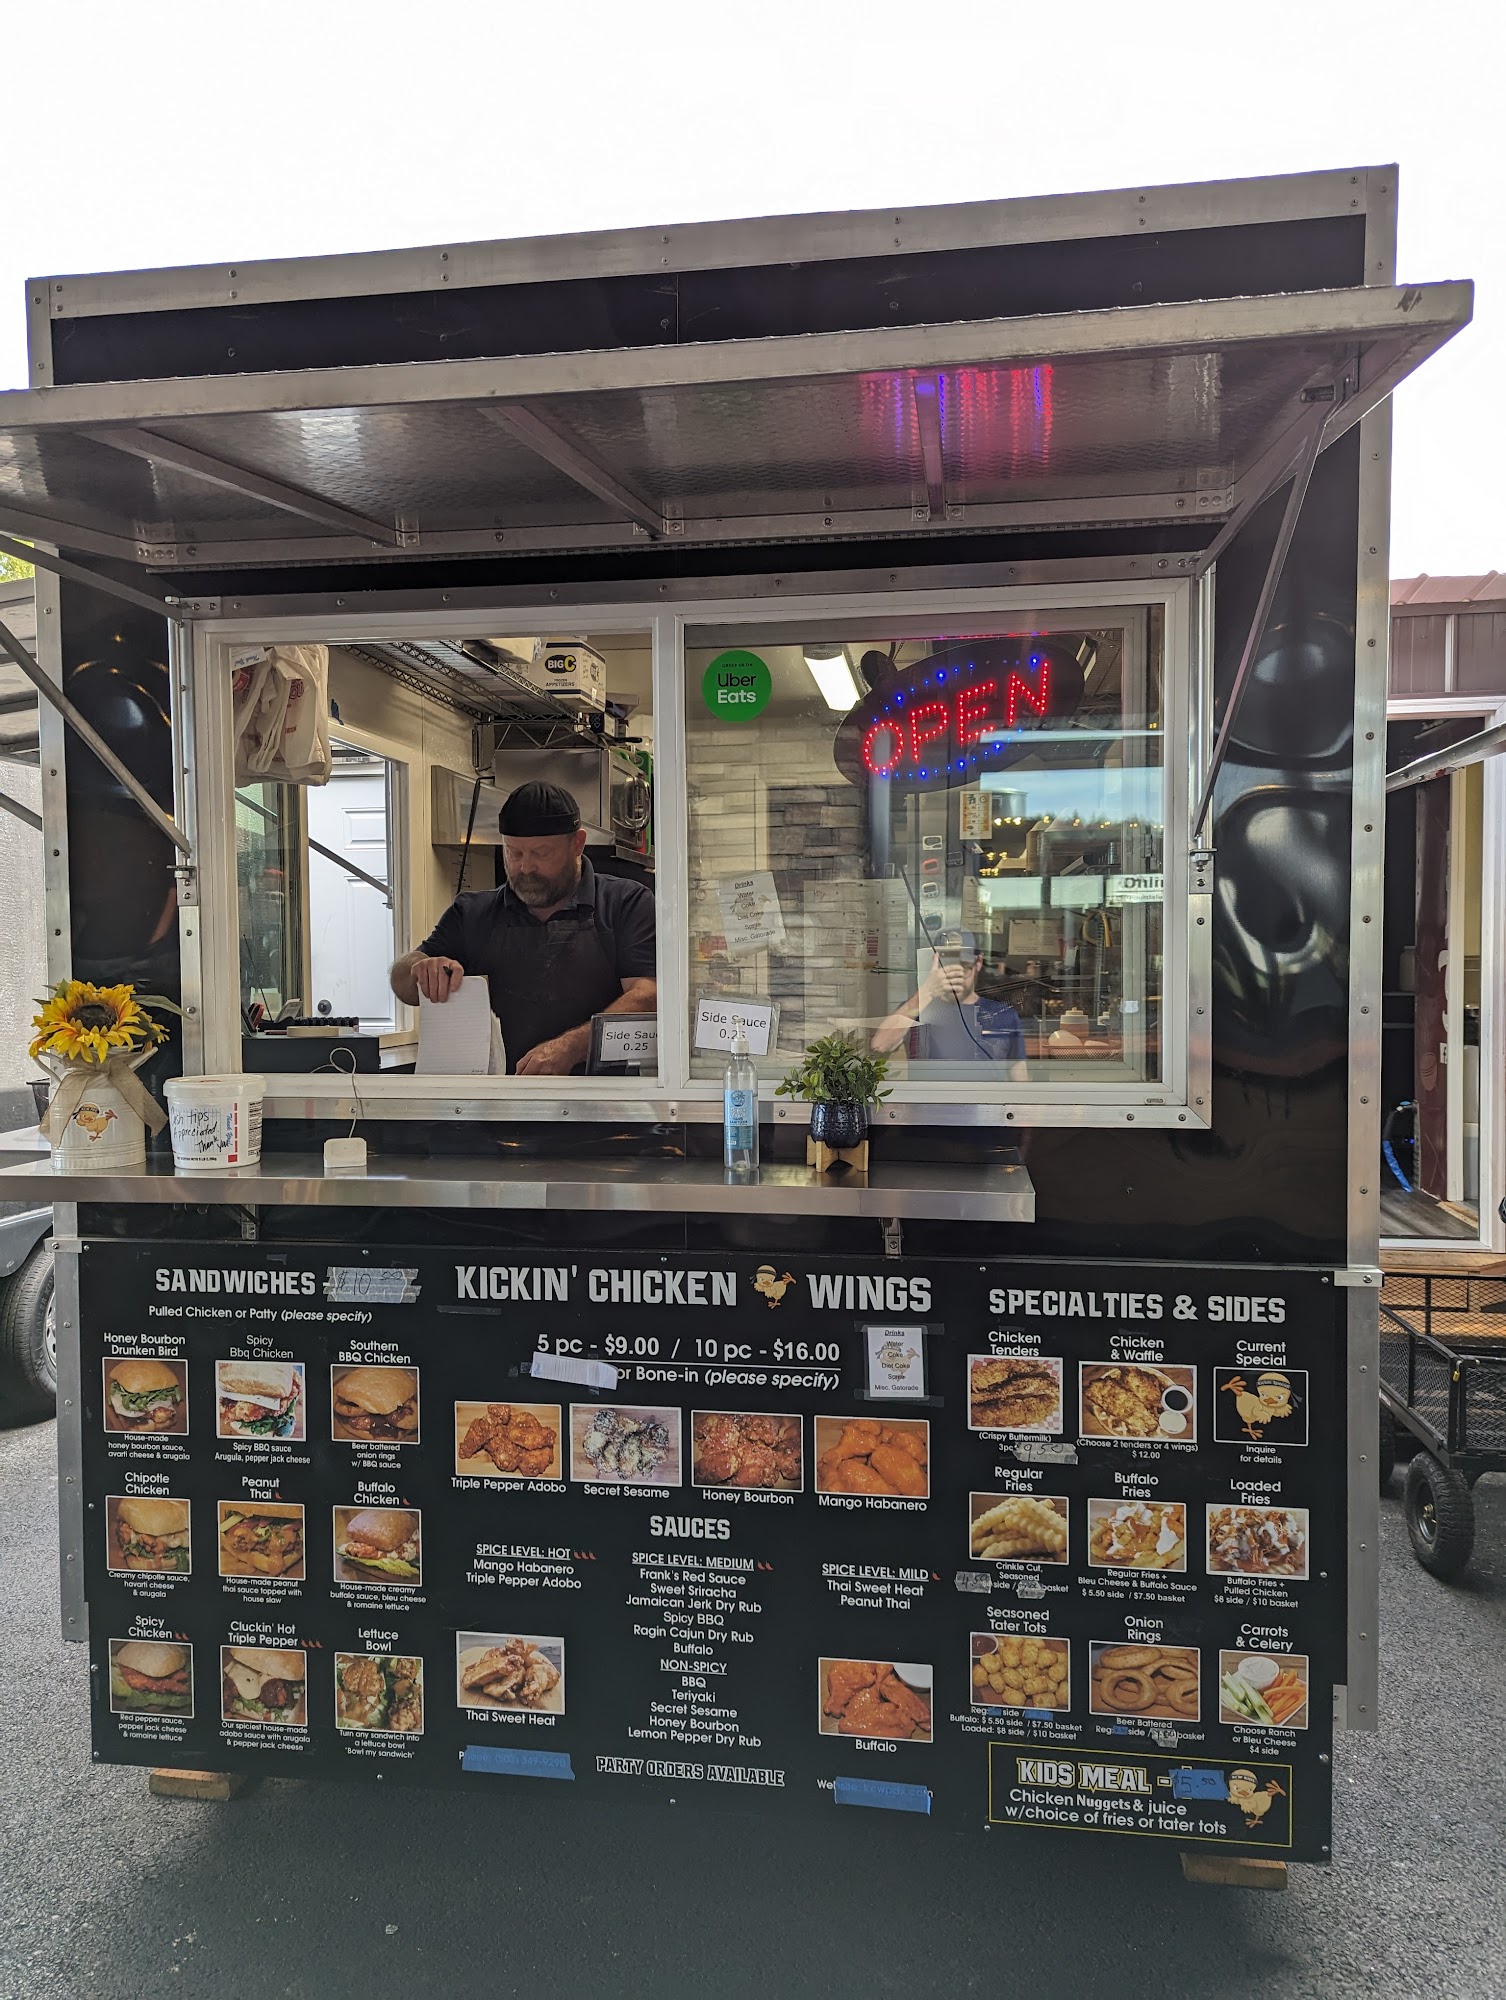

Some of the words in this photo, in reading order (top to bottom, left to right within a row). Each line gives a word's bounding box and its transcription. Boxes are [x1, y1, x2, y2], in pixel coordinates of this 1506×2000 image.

[717, 673, 757, 687] Uber
[717, 689, 757, 704] Eats
[863, 658, 1050, 773] OPEN
[734, 880, 754, 889] Drinks
[701, 1011, 728, 1024] Side
[605, 1031, 631, 1041] Side
[634, 1030, 658, 1040] Sau
[623, 1042, 649, 1051] 0.25
[187, 1108, 210, 1127] tips
[156, 1269, 316, 1295] SANDWICHES
[455, 1266, 577, 1302] KICKIN'
[589, 1269, 737, 1306] CHICKEN
[806, 1274, 932, 1312] WINGS
[989, 1289, 1163, 1320] SPECIALTIES
[1173, 1295, 1198, 1320] &
[1208, 1296, 1286, 1323] SIDES
[149, 1305, 183, 1317] Pulled
[185, 1306, 232, 1318] Chicken
[235, 1310, 247, 1319] or
[250, 1308, 277, 1322] Patty
[281, 1309, 324, 1322] (please
[326, 1311, 372, 1324] specify)
[104, 1332, 138, 1347] Honey
[141, 1333, 186, 1347] Bourbon
[246, 1334, 274, 1348] Spicy
[988, 1331, 1041, 1344] Chicken
[1110, 1336, 1164, 1349] Chicken
[112, 1345, 155, 1356] Drunken
[158, 1346, 178, 1356] Bird
[350, 1340, 399, 1352] Southern
[537, 1334, 549, 1352] 5
[556, 1338, 583, 1355] pc
[605, 1335, 659, 1356] $9.00
[696, 1339, 717, 1358] 10
[724, 1344, 752, 1360] pc
[773, 1340, 840, 1361] $16.00
[990, 1345, 1039, 1357] Tenders
[230, 1347, 250, 1360] Bbq
[253, 1348, 294, 1359] Chicken
[339, 1351, 362, 1363] BBQ
[364, 1352, 411, 1364] Chicken
[1111, 1349, 1120, 1360] &
[1123, 1349, 1164, 1362] Waffle
[124, 1434, 169, 1442] House-made
[233, 1442, 253, 1453] Spicy
[254, 1443, 270, 1452] BBQ
[1246, 1445, 1276, 1455] Inquire
[215, 1452, 244, 1463] Arugula,
[245, 1455, 269, 1464] pepper
[270, 1454, 285, 1464] jack
[286, 1455, 311, 1464] cheese
[1253, 1455, 1282, 1464] details
[125, 1472, 170, 1486] Chipotle
[995, 1466, 1043, 1481] Regular
[1115, 1472, 1159, 1485] Buffalo
[125, 1483, 170, 1495] Chicken
[242, 1476, 280, 1488] Peanut
[358, 1481, 396, 1493] Buffalo
[451, 1477, 481, 1490] Triple
[484, 1479, 525, 1492] Pepper
[527, 1479, 567, 1493] Adobo
[1005, 1480, 1033, 1492] Fries
[250, 1488, 272, 1499] Thai
[703, 1489, 741, 1504] Honey
[744, 1490, 794, 1504] Bourbon
[1122, 1485, 1151, 1498] Fries
[354, 1493, 400, 1505] Chicken
[819, 1495, 863, 1510] Mango
[866, 1497, 927, 1511] Habanero
[650, 1515, 730, 1540] SAUCES
[640, 1568, 680, 1581] Frank's
[683, 1571, 706, 1583] Red
[709, 1572, 746, 1585] Sauce
[124, 1580, 148, 1588] havarti
[149, 1582, 175, 1590] cheese
[987, 1606, 1050, 1621] Seasoned
[135, 1615, 165, 1629] Spicy
[230, 1621, 274, 1634] Cluckin'
[277, 1623, 296, 1635] Hot
[990, 1619, 1020, 1632] Tater
[1023, 1621, 1047, 1633] Tots
[1124, 1616, 1163, 1629] Onion
[128, 1627, 173, 1639] Chicken
[358, 1628, 399, 1640] Lettuce
[1128, 1629, 1161, 1643] Rings
[1240, 1623, 1289, 1637] Carrots
[227, 1632, 257, 1644] Triple
[259, 1634, 298, 1648] Pepper
[366, 1640, 392, 1652] Bowl
[1236, 1636, 1245, 1647] &
[1249, 1637, 1293, 1652] Celery
[660, 1659, 727, 1673] NON-SPICY
[672, 1689, 716, 1703] Teriyaki
[628, 1727, 667, 1740] Lemon
[671, 1730, 713, 1744] Pepper
[716, 1733, 735, 1747] Dry
[739, 1735, 762, 1747] Rub
[596, 1756, 645, 1775] PARTY
[646, 1760, 704, 1780] ORDERS
[707, 1764, 785, 1787] AVAILABLE
[1016, 1757, 1075, 1788] KIDS
[1078, 1762, 1152, 1795] MEAL
[1010, 1789, 1074, 1806] Chicken
[1077, 1794, 1131, 1811] Nuggets
[1133, 1799, 1144, 1812] &
[1148, 1800, 1187, 1816] juice
[1005, 1805, 1079, 1822] w/choice
[1084, 1809, 1099, 1824] of
[1103, 1810, 1134, 1827] fries
[1138, 1813, 1155, 1829] or
[1158, 1816, 1195, 1832] tater
[1199, 1820, 1227, 1835] tots
